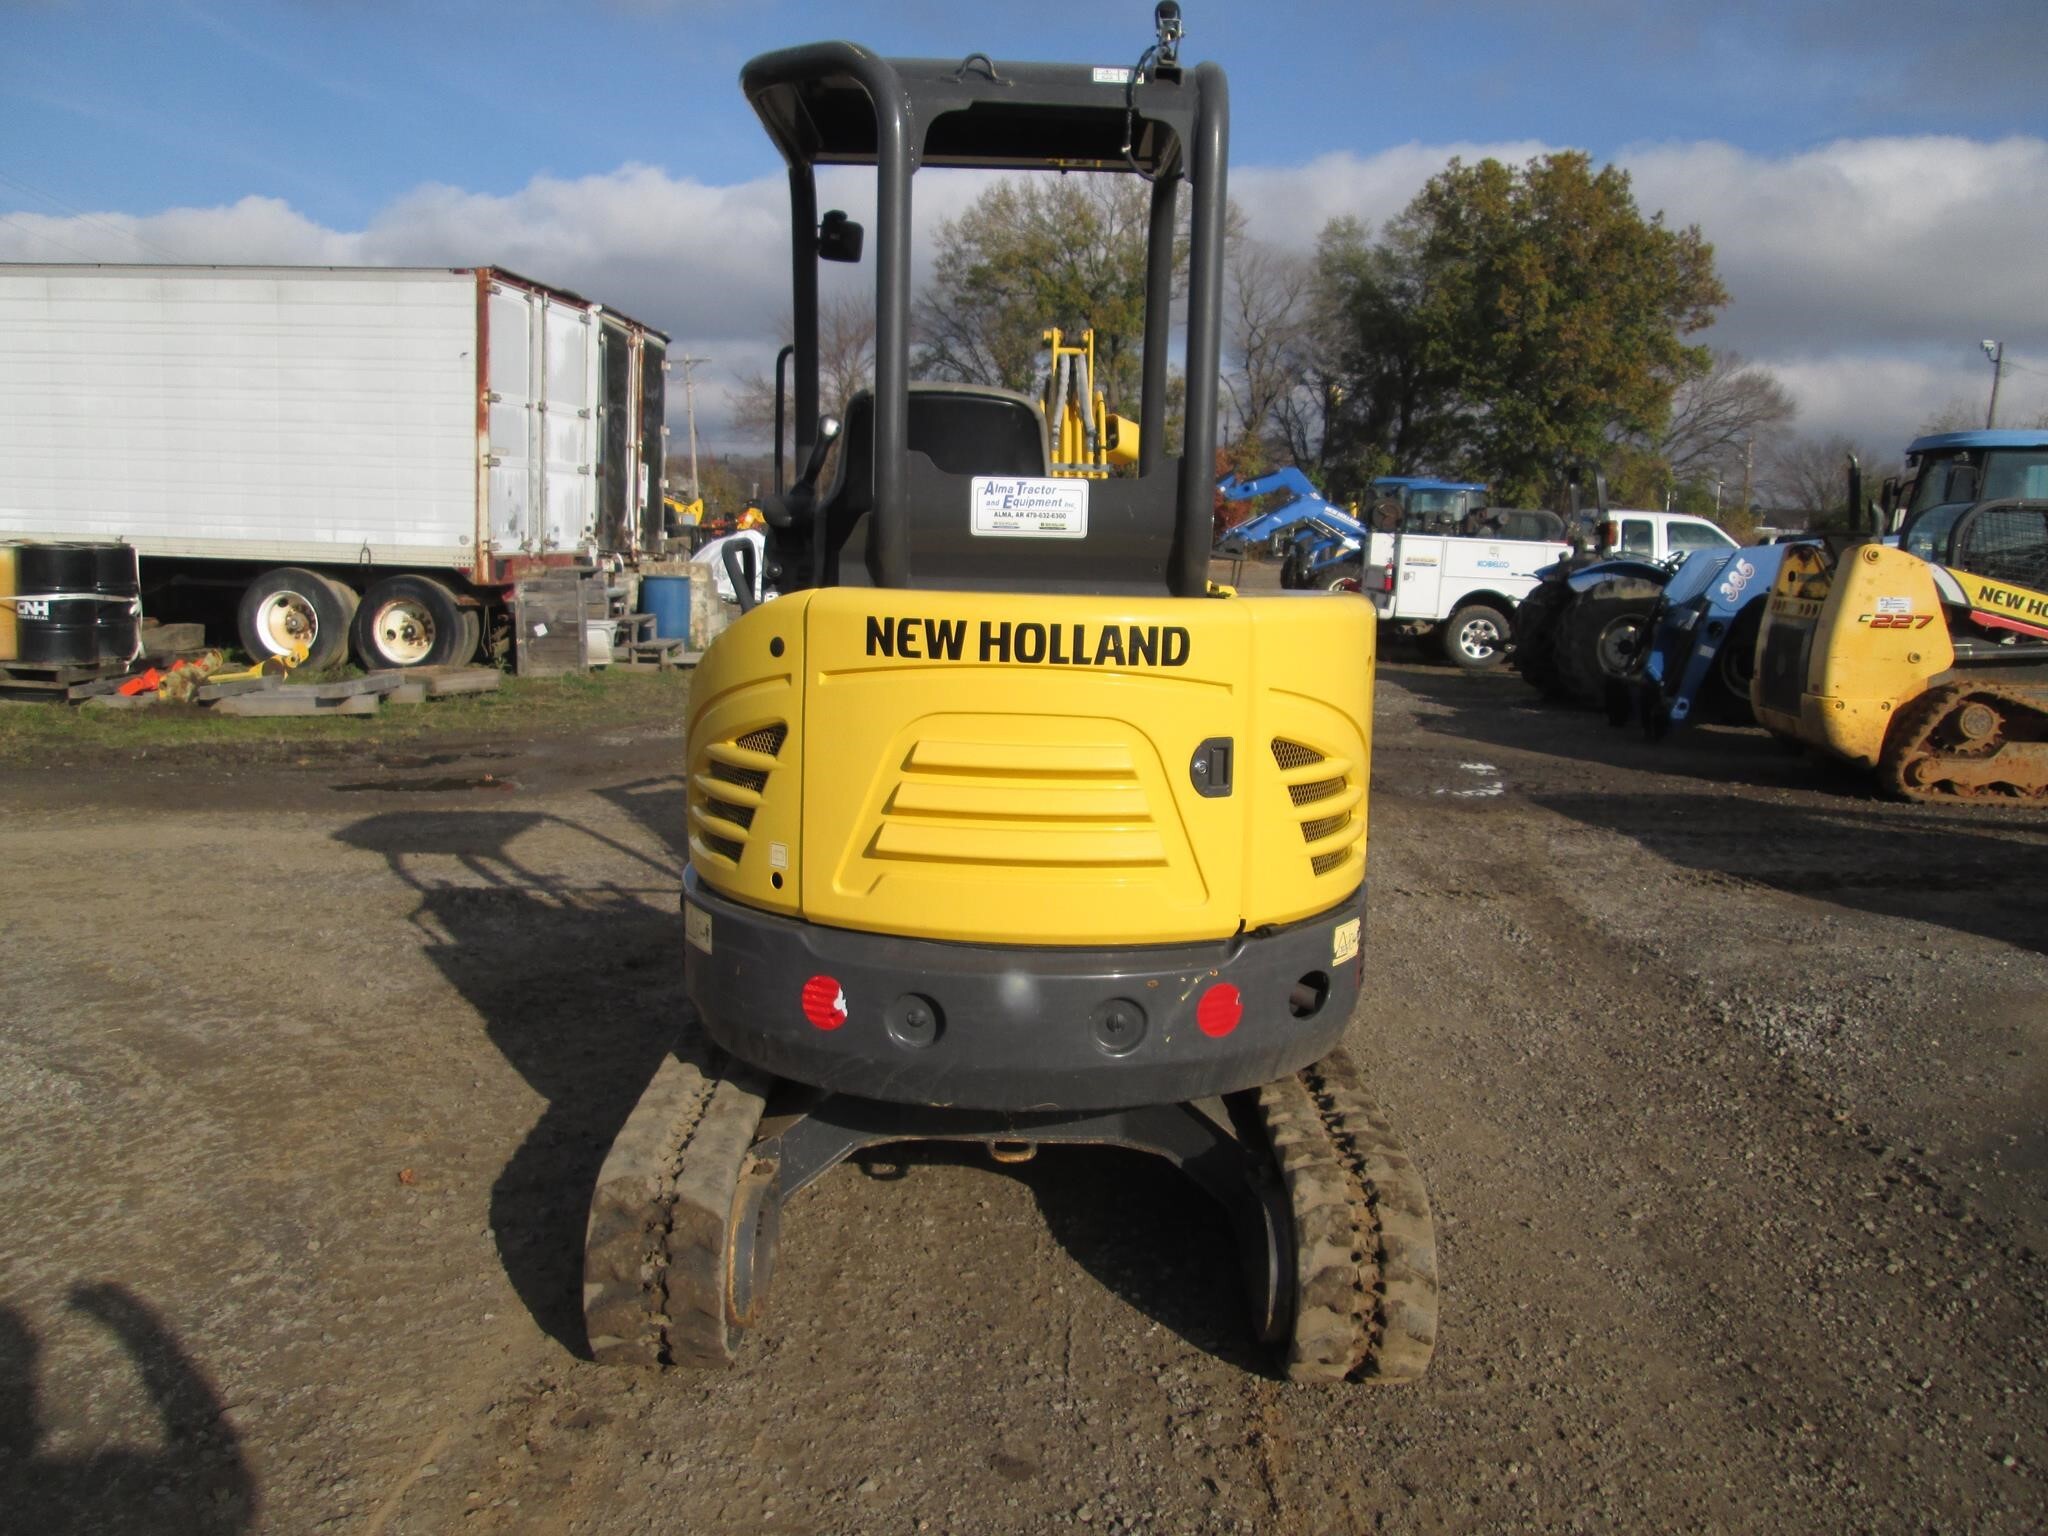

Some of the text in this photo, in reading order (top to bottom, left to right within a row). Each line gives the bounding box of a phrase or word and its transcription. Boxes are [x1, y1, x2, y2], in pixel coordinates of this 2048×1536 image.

[984, 481, 1057, 496] Alma Tractor
[1003, 494, 1063, 509] Equipment
[994, 511, 1014, 520] ALMA,
[1476, 560, 1510, 569] KOBELCO
[1978, 585, 2026, 610] NEW
[16, 601, 49, 616] CNH
[866, 615, 1191, 667] NEW HOLLAND
